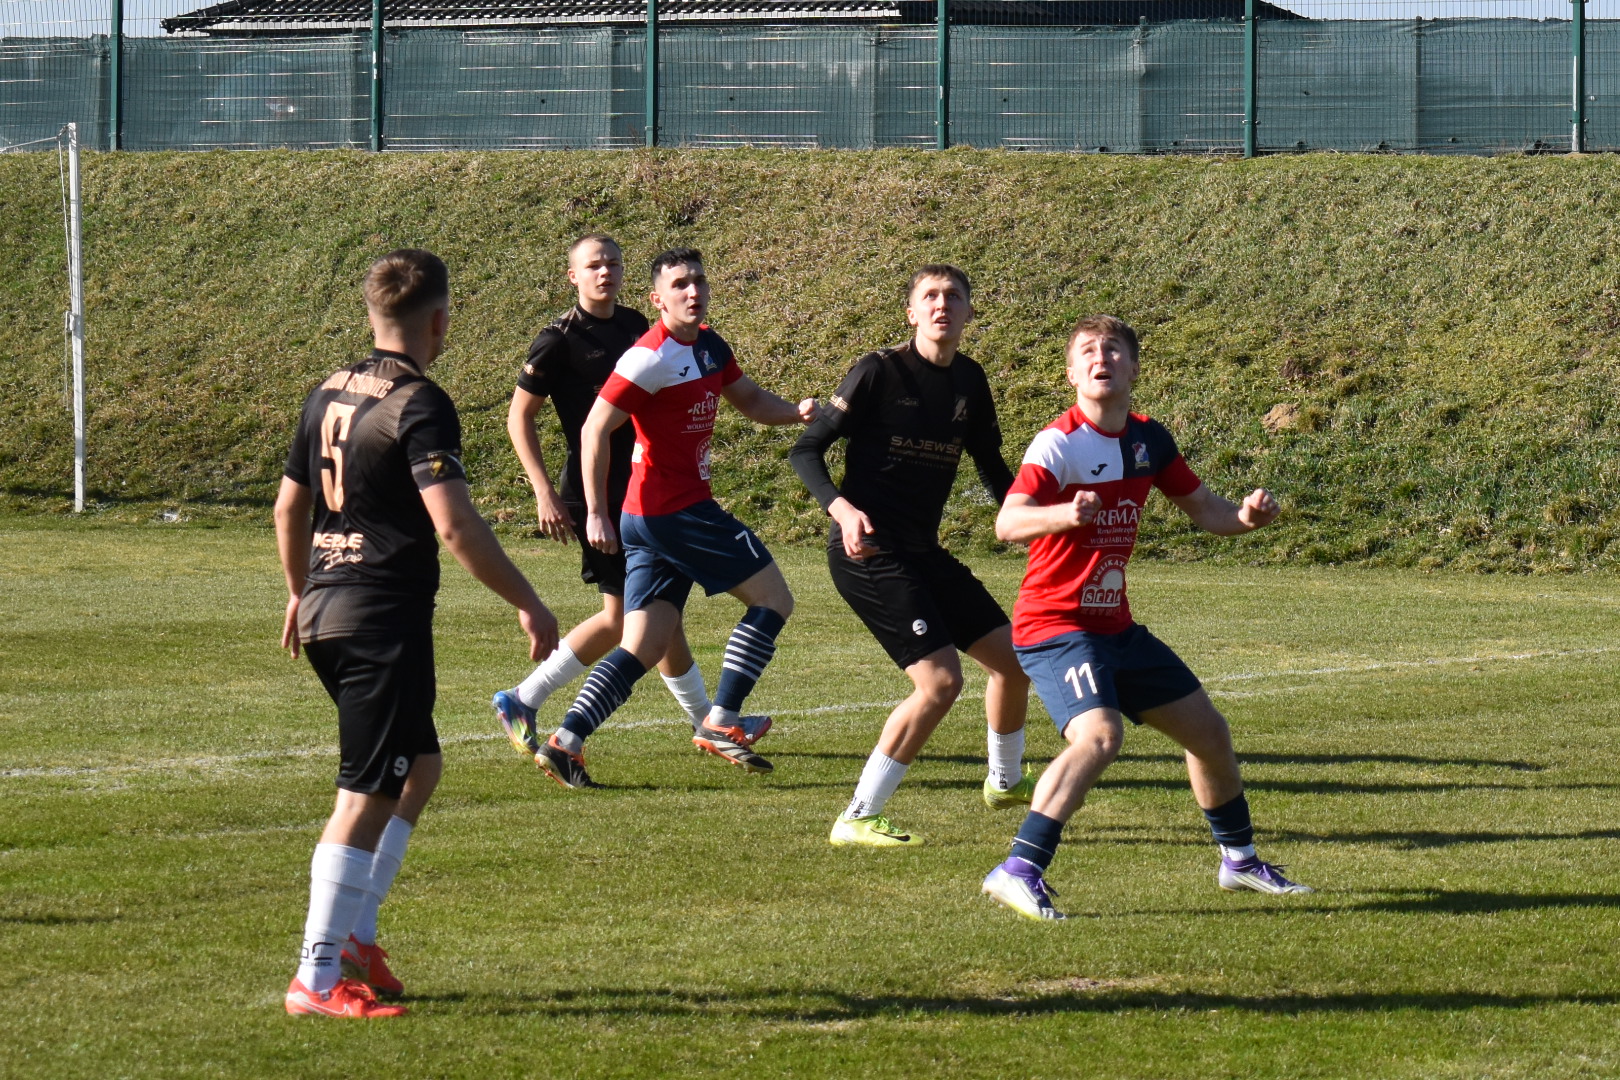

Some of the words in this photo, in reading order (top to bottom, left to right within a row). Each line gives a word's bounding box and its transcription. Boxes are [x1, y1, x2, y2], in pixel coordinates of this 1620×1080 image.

[321, 401, 356, 512] 5
[734, 530, 760, 559] 7
[1064, 662, 1098, 699] 11
